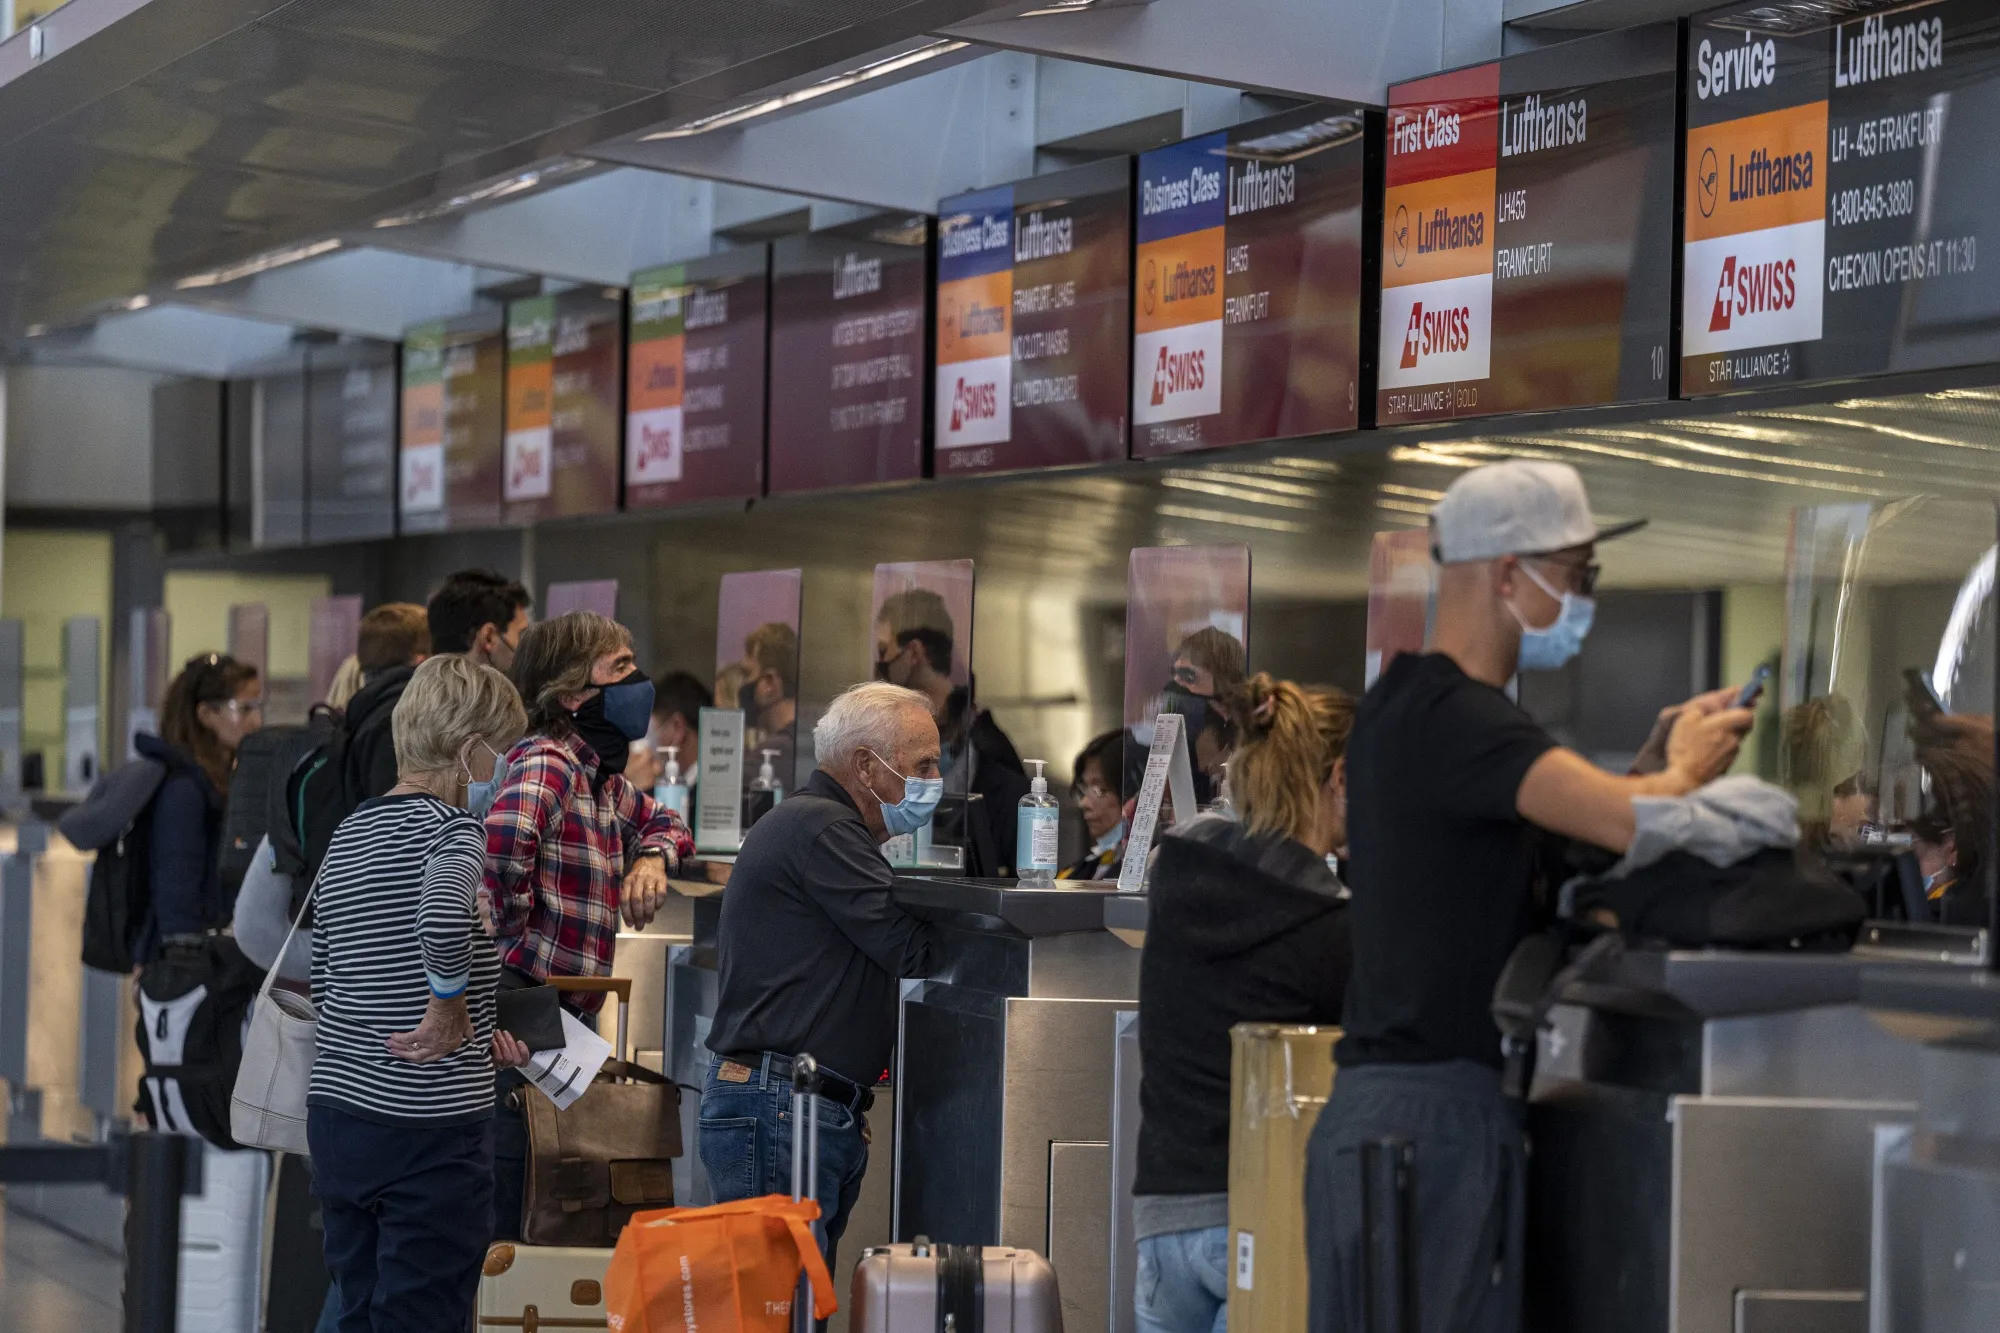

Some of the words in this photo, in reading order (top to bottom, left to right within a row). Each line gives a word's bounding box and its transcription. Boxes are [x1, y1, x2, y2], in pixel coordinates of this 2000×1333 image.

[1697, 31, 1776, 100] Service
[1835, 14, 1943, 89] Lufthansa
[1393, 116, 1422, 157] First
[1424, 108, 1460, 151] Class
[1501, 95, 1587, 158] Lufthansa
[1832, 128, 1848, 163] LH
[1856, 121, 1877, 158] 455
[1879, 107, 1944, 154] FRAKFURT
[1143, 176, 1189, 215] Business
[1190, 166, 1220, 204] Class
[1229, 160, 1295, 216] Lufthansa
[1730, 148, 1813, 202] Lufthansa
[1499, 189, 1527, 223] LH455
[1831, 178, 1914, 227] 1-800-645-3880
[1014, 211, 1072, 262] Lufthansa
[1417, 208, 1484, 255] Lufthansa
[1163, 260, 1216, 303] Lufthansa
[1497, 242, 1553, 279] FRANKFURT
[1828, 253, 1881, 292] CHECKIN
[1884, 244, 1926, 284] OPENS
[1926, 241, 1944, 278] AT
[1946, 236, 1976, 275] 11:30
[1225, 292, 1270, 325] FRANKFURT
[1737, 257, 1796, 317] SWISS
[1422, 307, 1470, 357] SWISS
[1167, 350, 1205, 394] SWISS
[1651, 345, 1664, 381] 10
[1709, 358, 1732, 382] STAR
[1733, 352, 1779, 380] ALLIANCE
[1388, 393, 1407, 414] STAR
[1408, 388, 1444, 412] ALLIANCE
[1456, 387, 1477, 408] GOLD
